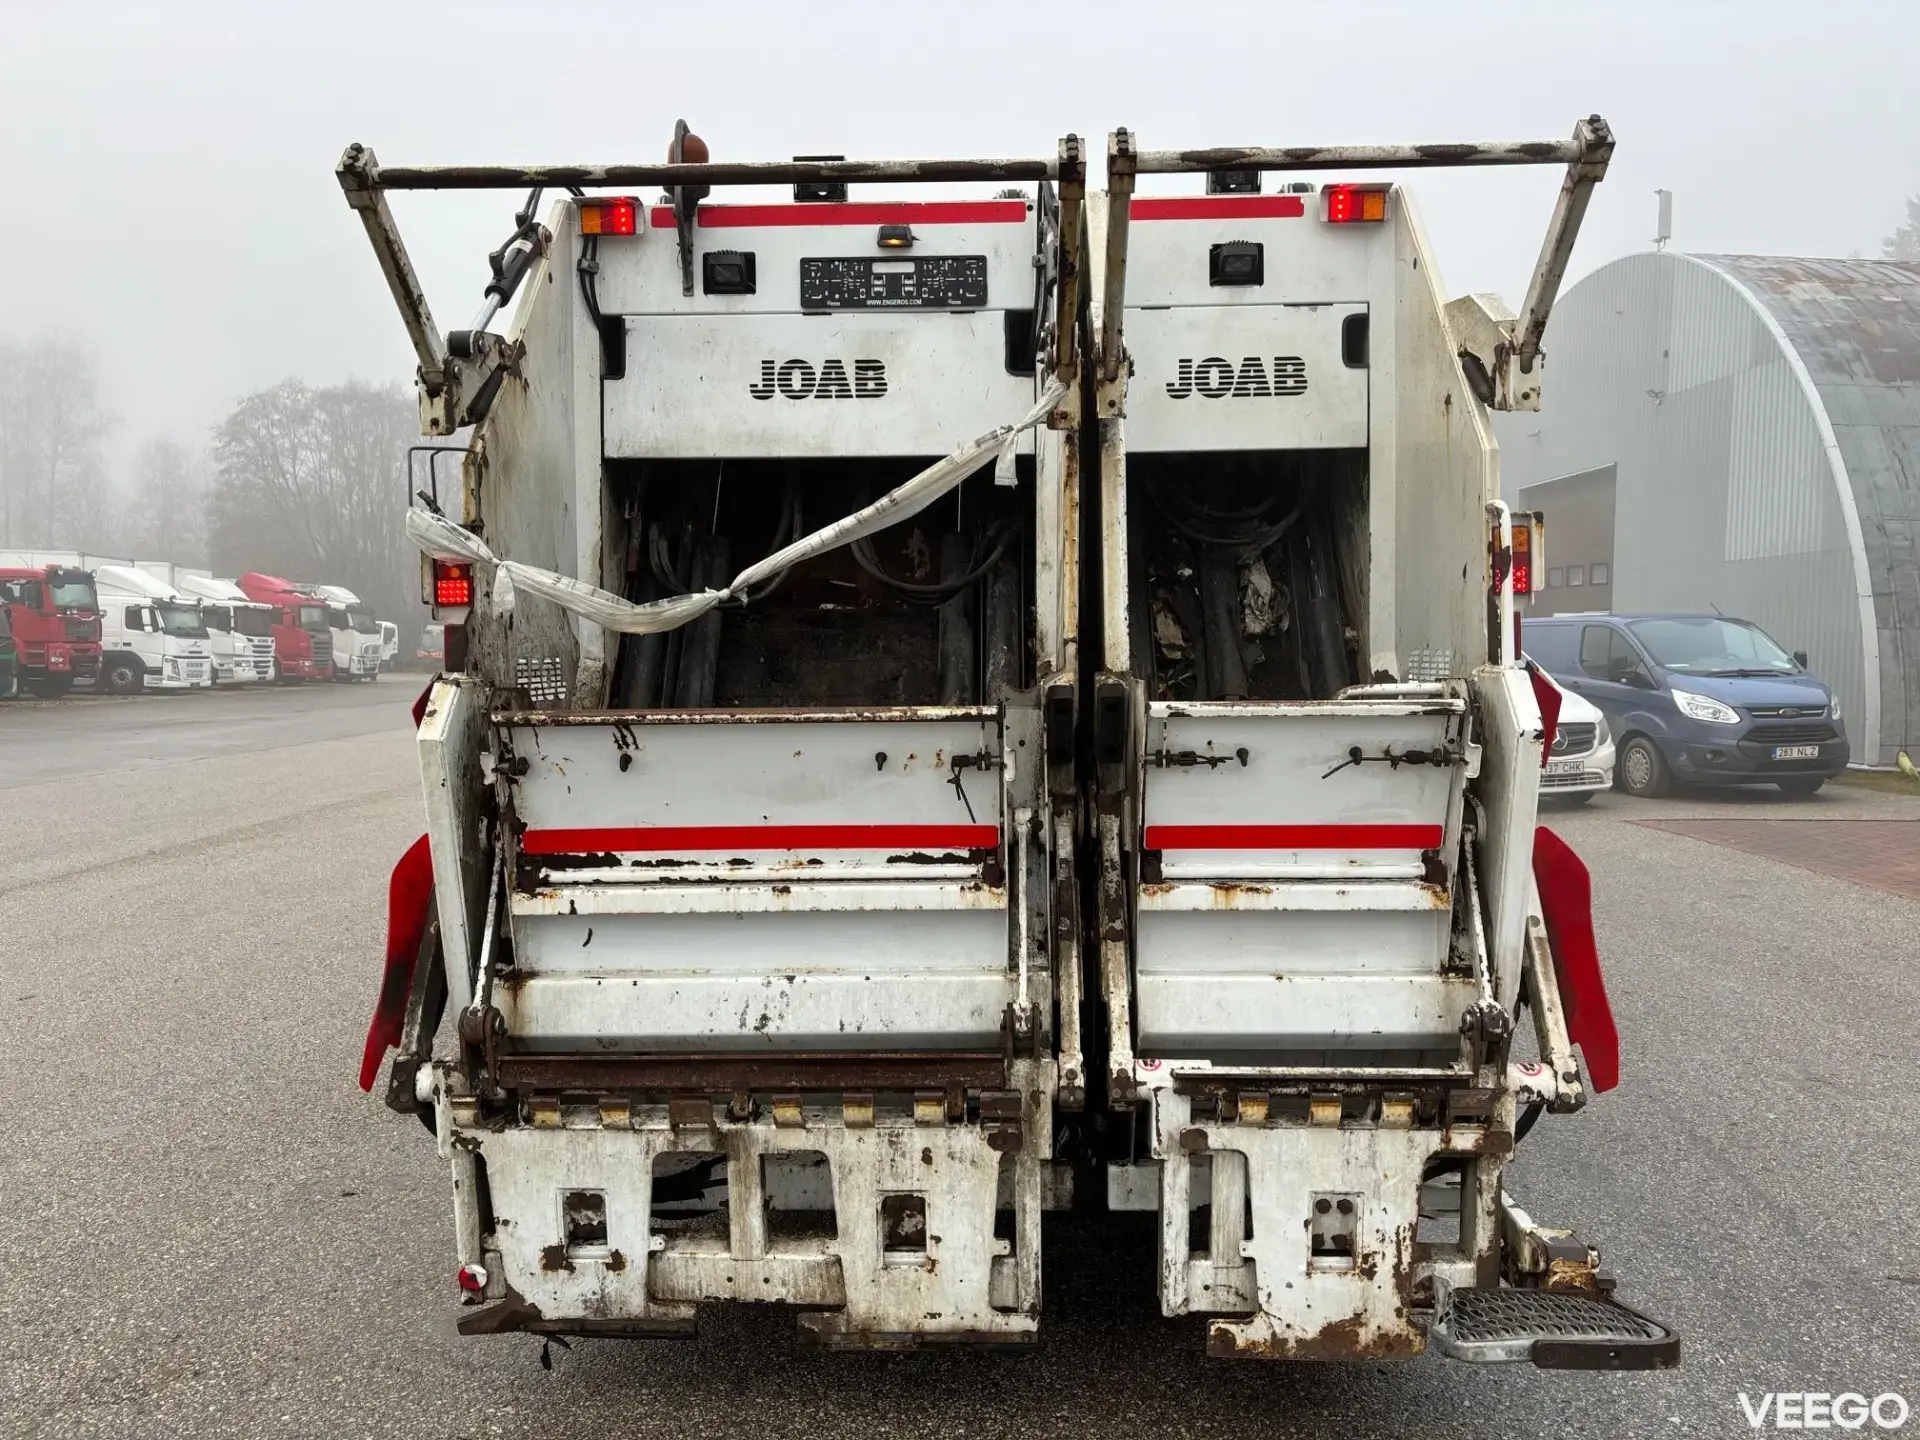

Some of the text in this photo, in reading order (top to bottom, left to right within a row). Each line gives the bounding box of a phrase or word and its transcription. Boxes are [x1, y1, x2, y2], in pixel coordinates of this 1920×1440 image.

[749, 358, 888, 401] JOAB
[1166, 356, 1309, 400] JOAB
[1778, 748, 1794, 757] 283
[1562, 762, 1581, 773] CHK
